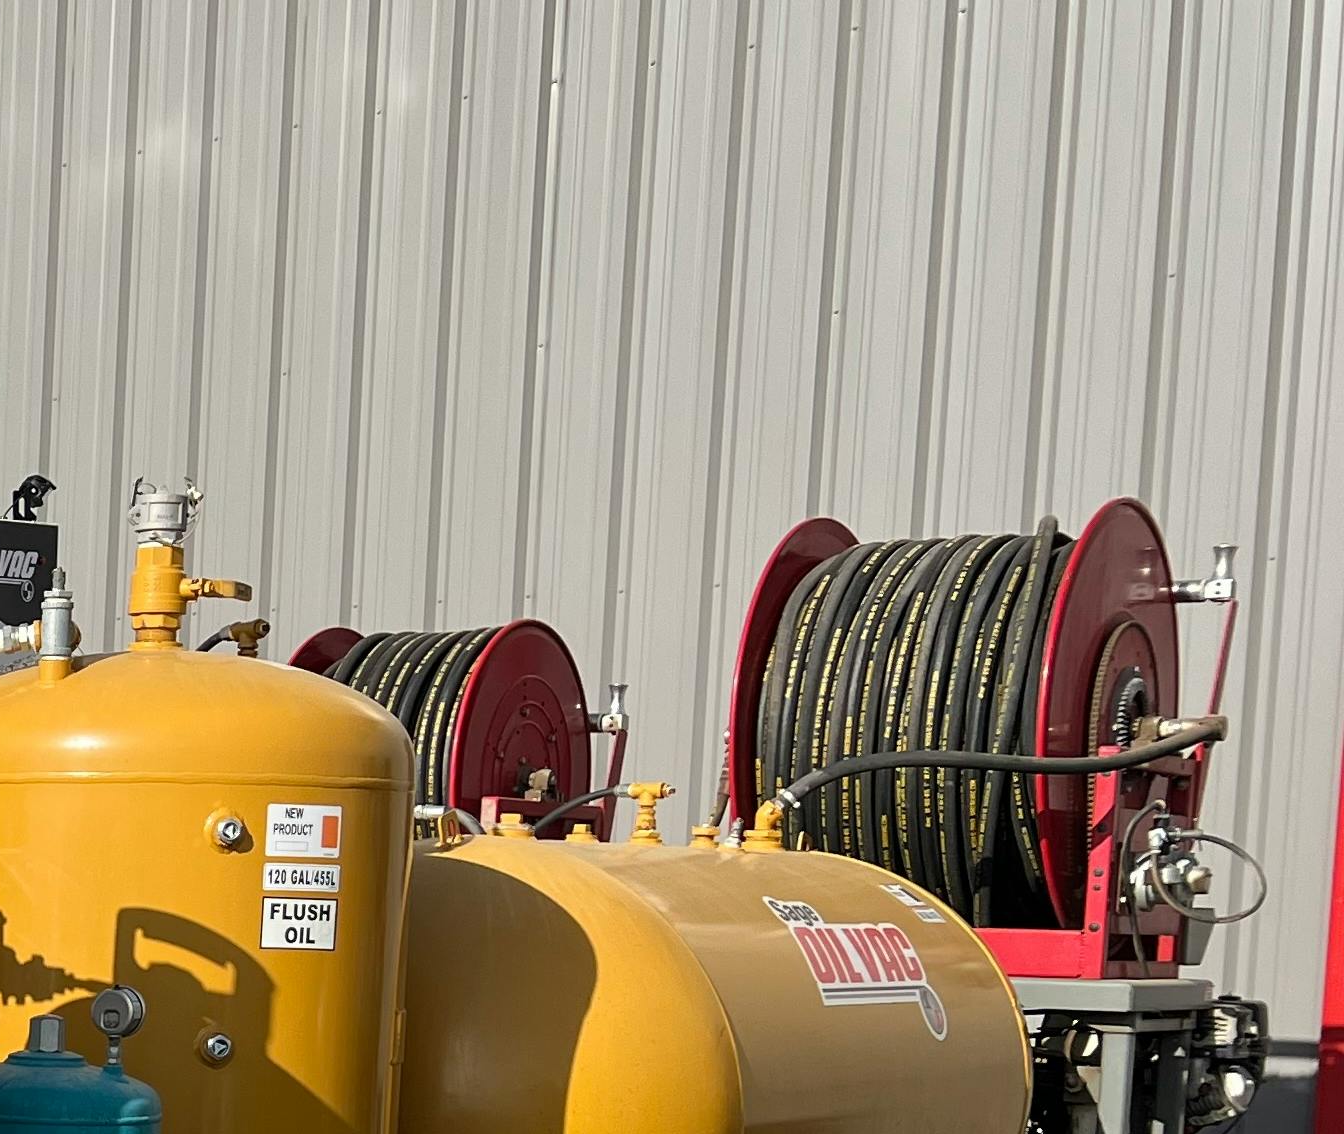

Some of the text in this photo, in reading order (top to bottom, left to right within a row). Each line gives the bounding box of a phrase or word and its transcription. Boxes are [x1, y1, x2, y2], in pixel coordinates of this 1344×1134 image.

[285, 808, 304, 819] NEW
[273, 824, 313, 836] PRODUCT
[268, 869, 336, 886] 120 GAL/455L
[270, 903, 331, 921] FLUSH
[768, 900, 819, 926] Sage
[284, 926, 315, 944] OIL
[794, 927, 923, 983] OIL VAC
